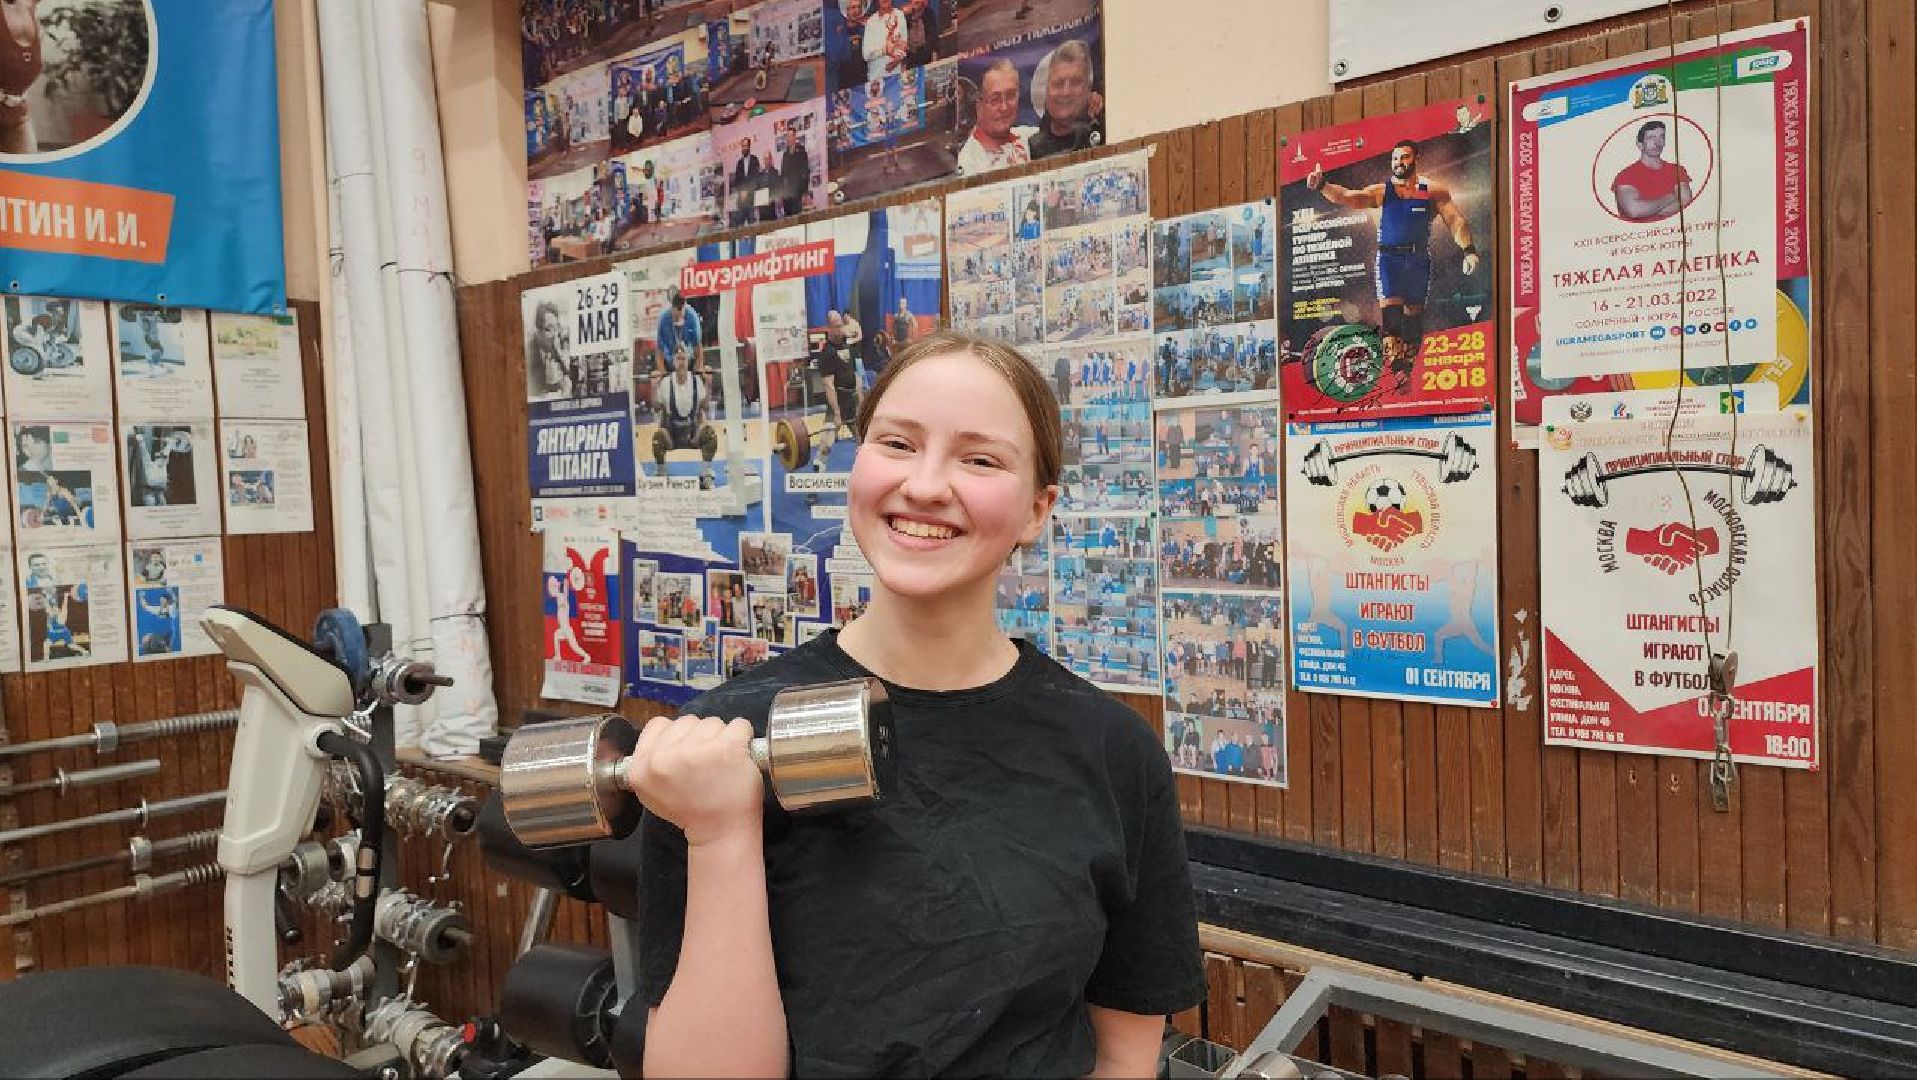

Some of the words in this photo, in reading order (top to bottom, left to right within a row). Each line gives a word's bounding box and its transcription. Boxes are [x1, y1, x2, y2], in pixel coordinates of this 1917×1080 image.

[1782, 79, 1799, 148] ТЯЖЕЛАЯ
[1520, 132, 1533, 167] 2022
[1784, 151, 1800, 224] АТЛЕТИКА
[1520, 169, 1533, 233] АТЛЕТИКА
[84, 207, 147, 248] И.И.
[1785, 226, 1801, 266] 2022
[683, 247, 829, 294] Пауэрлифтинг
[1553, 263, 1643, 288] ТЯЖЕЛАЯ
[1652, 250, 1760, 277] АТЛЕТИКА
[1592, 300, 1609, 313] 16
[1626, 288, 1717, 308] 21.03.2022
[578, 308, 619, 345] МАЯ
[1556, 331, 1645, 346] UGRAMEGASPORT
[1423, 331, 1485, 354] 23-28
[1422, 367, 1486, 391] 2018
[536, 421, 619, 455] ЯНТАРНАЯ
[548, 451, 612, 481] ШТАНГА
[1605, 450, 1713, 473] ПРИНЦИПИАЛЬНЫЙ
[1596, 519, 1621, 574] МОСКВА
[1345, 572, 1430, 592] ШТАНГИСТЫ
[1359, 602, 1416, 621] ИГРАЮТ
[1626, 613, 1720, 633] ШТАНГИСТЫ
[1353, 630, 1364, 649] В
[1366, 630, 1426, 652] ФУТБОЛ
[1643, 641, 1704, 661] ИГРАЮТ
[1424, 668, 1491, 691] СЕНТЯБРЯ
[1635, 670, 1645, 687] В
[1764, 733, 1811, 758] 18:00
